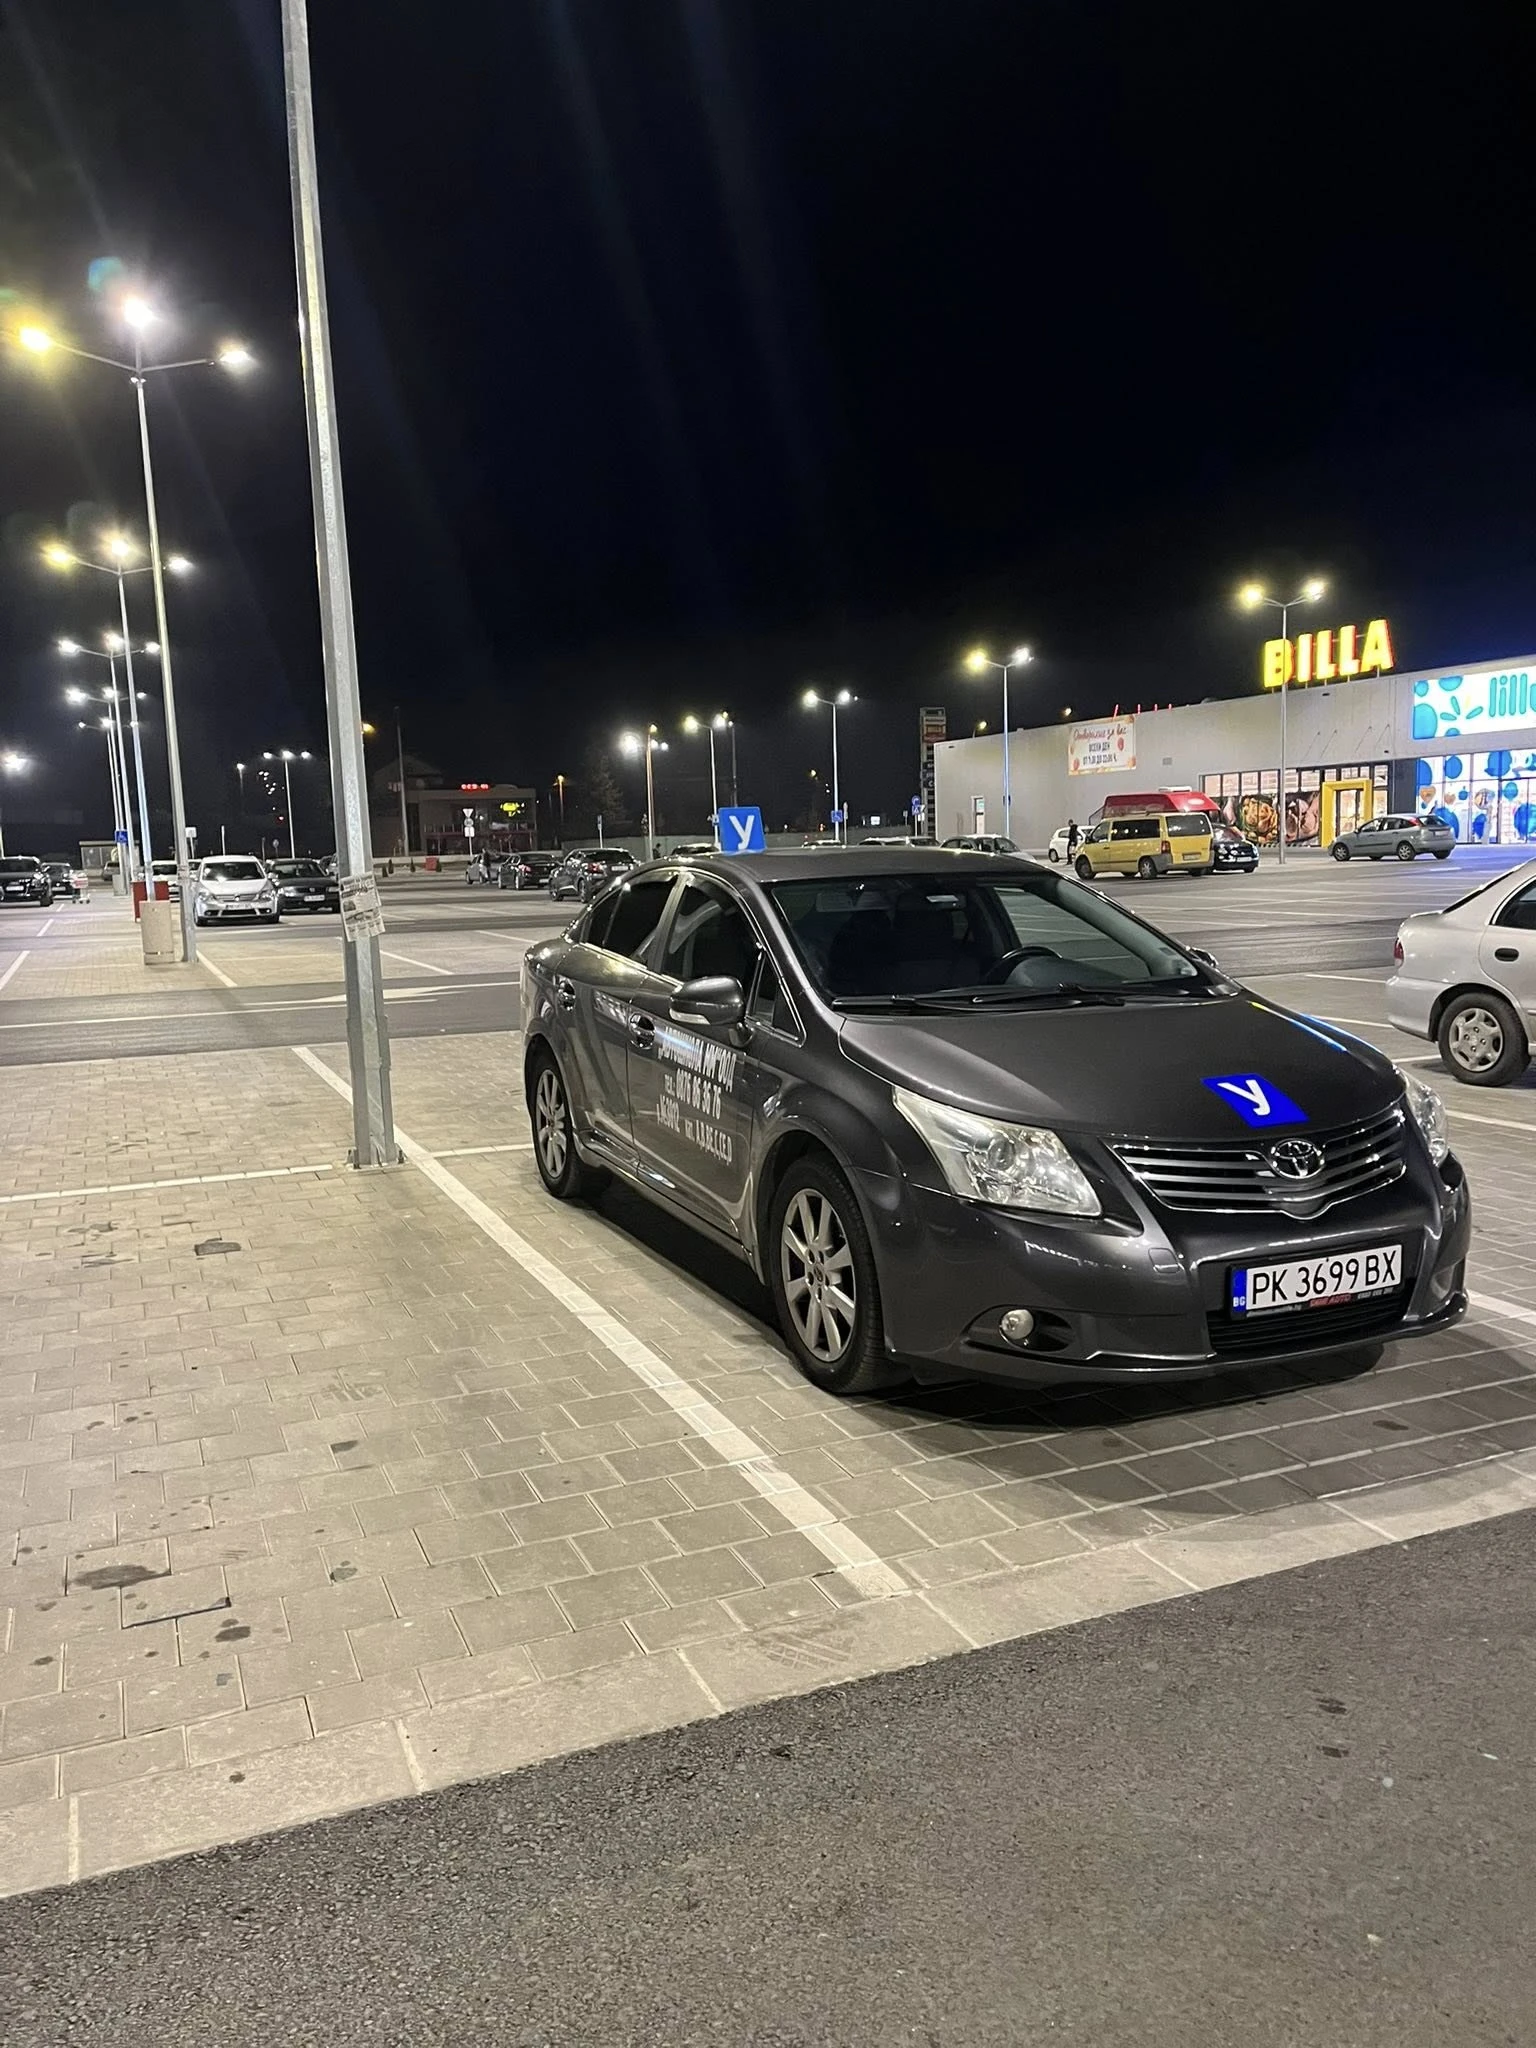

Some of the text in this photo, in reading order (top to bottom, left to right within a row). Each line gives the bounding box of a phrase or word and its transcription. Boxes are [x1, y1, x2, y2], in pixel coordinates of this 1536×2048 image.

[1263, 618, 1394, 689] BILLA
[1489, 673, 1536, 718] lill
[1232, 1296, 1246, 1308] BG
[1252, 1250, 1397, 1305] PK 3699 BX
